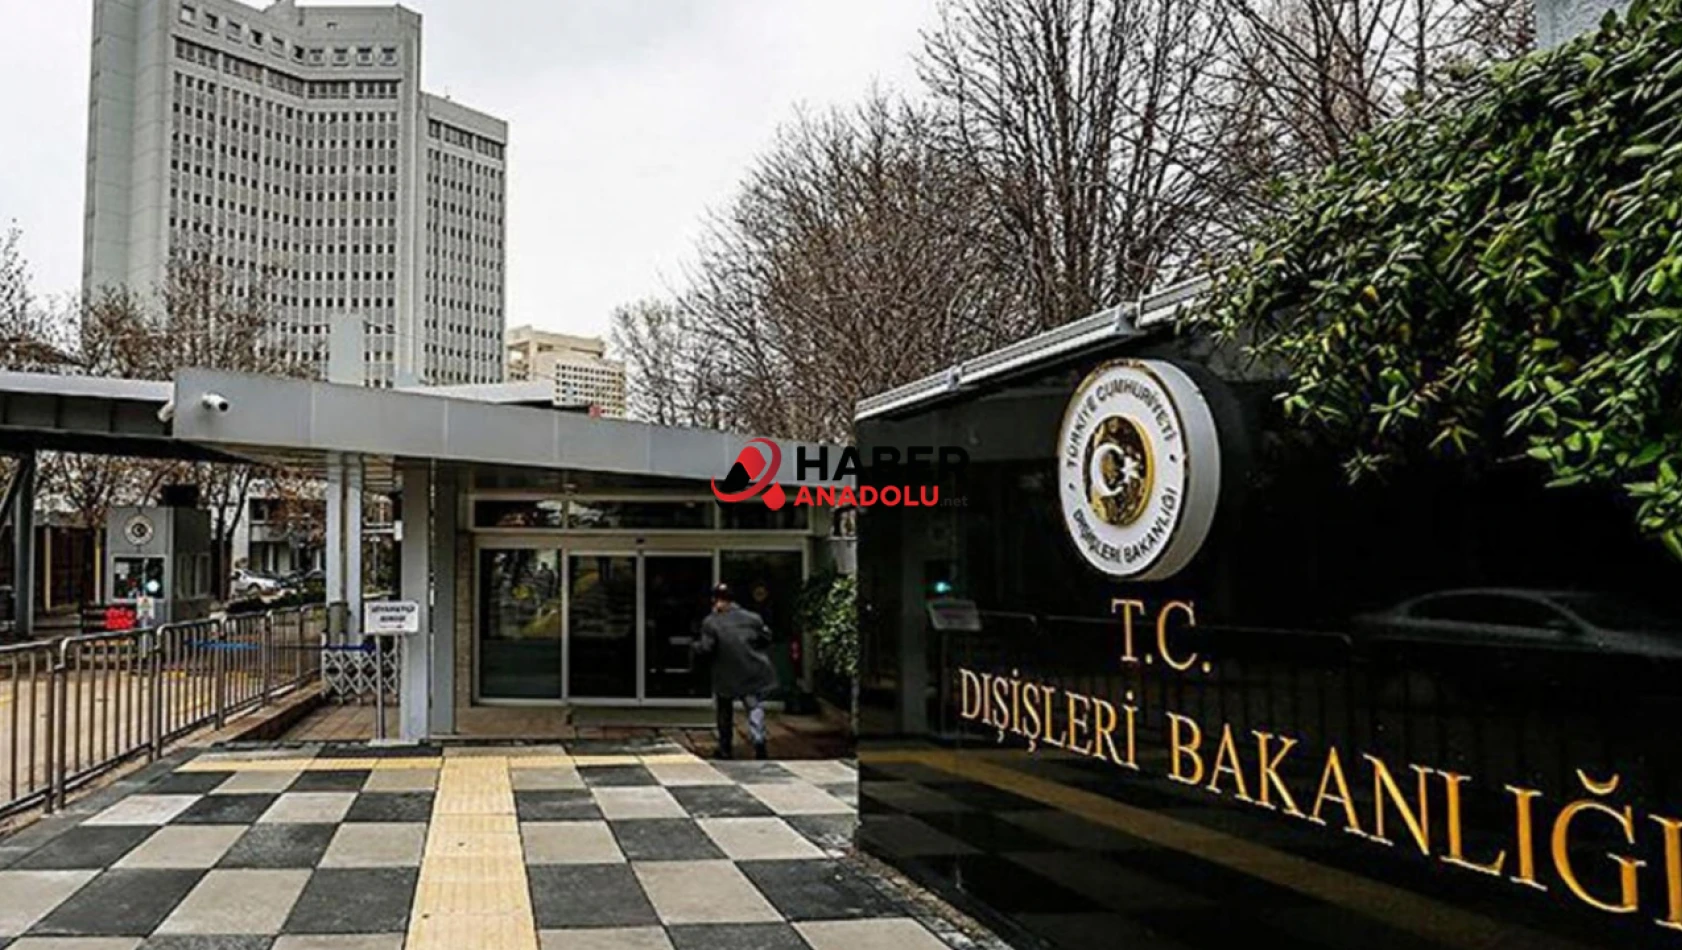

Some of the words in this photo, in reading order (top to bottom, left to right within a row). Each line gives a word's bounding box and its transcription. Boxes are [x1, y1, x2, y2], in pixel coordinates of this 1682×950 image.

[1111, 598, 1212, 674] T.C.
[959, 667, 1140, 772] DIŞİŞLERİ
[1165, 710, 1682, 932] BAKANLIĞI
